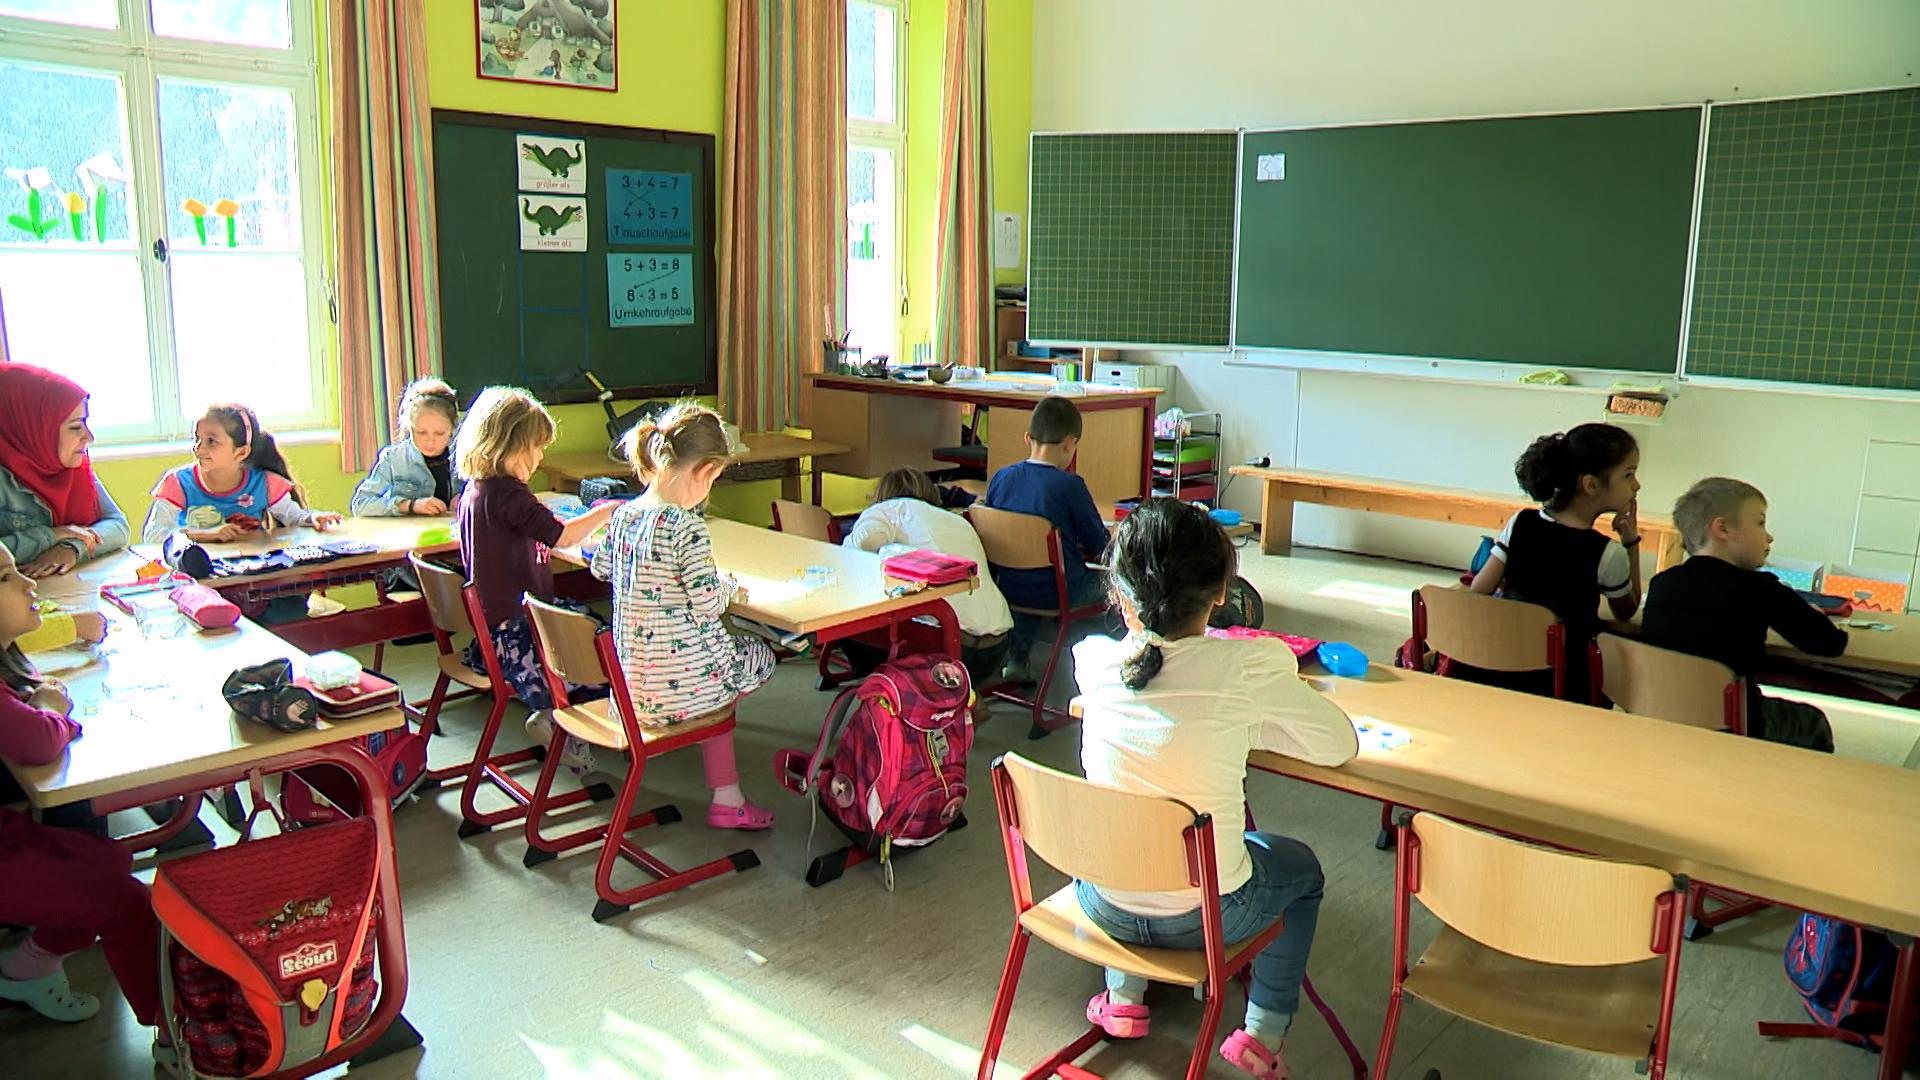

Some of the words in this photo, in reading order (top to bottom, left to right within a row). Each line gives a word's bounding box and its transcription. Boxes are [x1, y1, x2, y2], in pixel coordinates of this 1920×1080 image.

[622, 175, 630, 188] 3
[648, 175, 655, 189] 4
[672, 176, 679, 189] 7
[623, 207, 630, 219] 4
[648, 207, 656, 220] 3
[672, 207, 679, 219] 7
[624, 259, 632, 272] 5
[649, 257, 657, 272] 3
[672, 257, 680, 270] 8
[627, 289, 635, 302] 8
[648, 288, 656, 301] 3
[671, 287, 679, 300] 5
[614, 305, 692, 319] Umkehraufgabe
[283, 949, 333, 974] Scout
